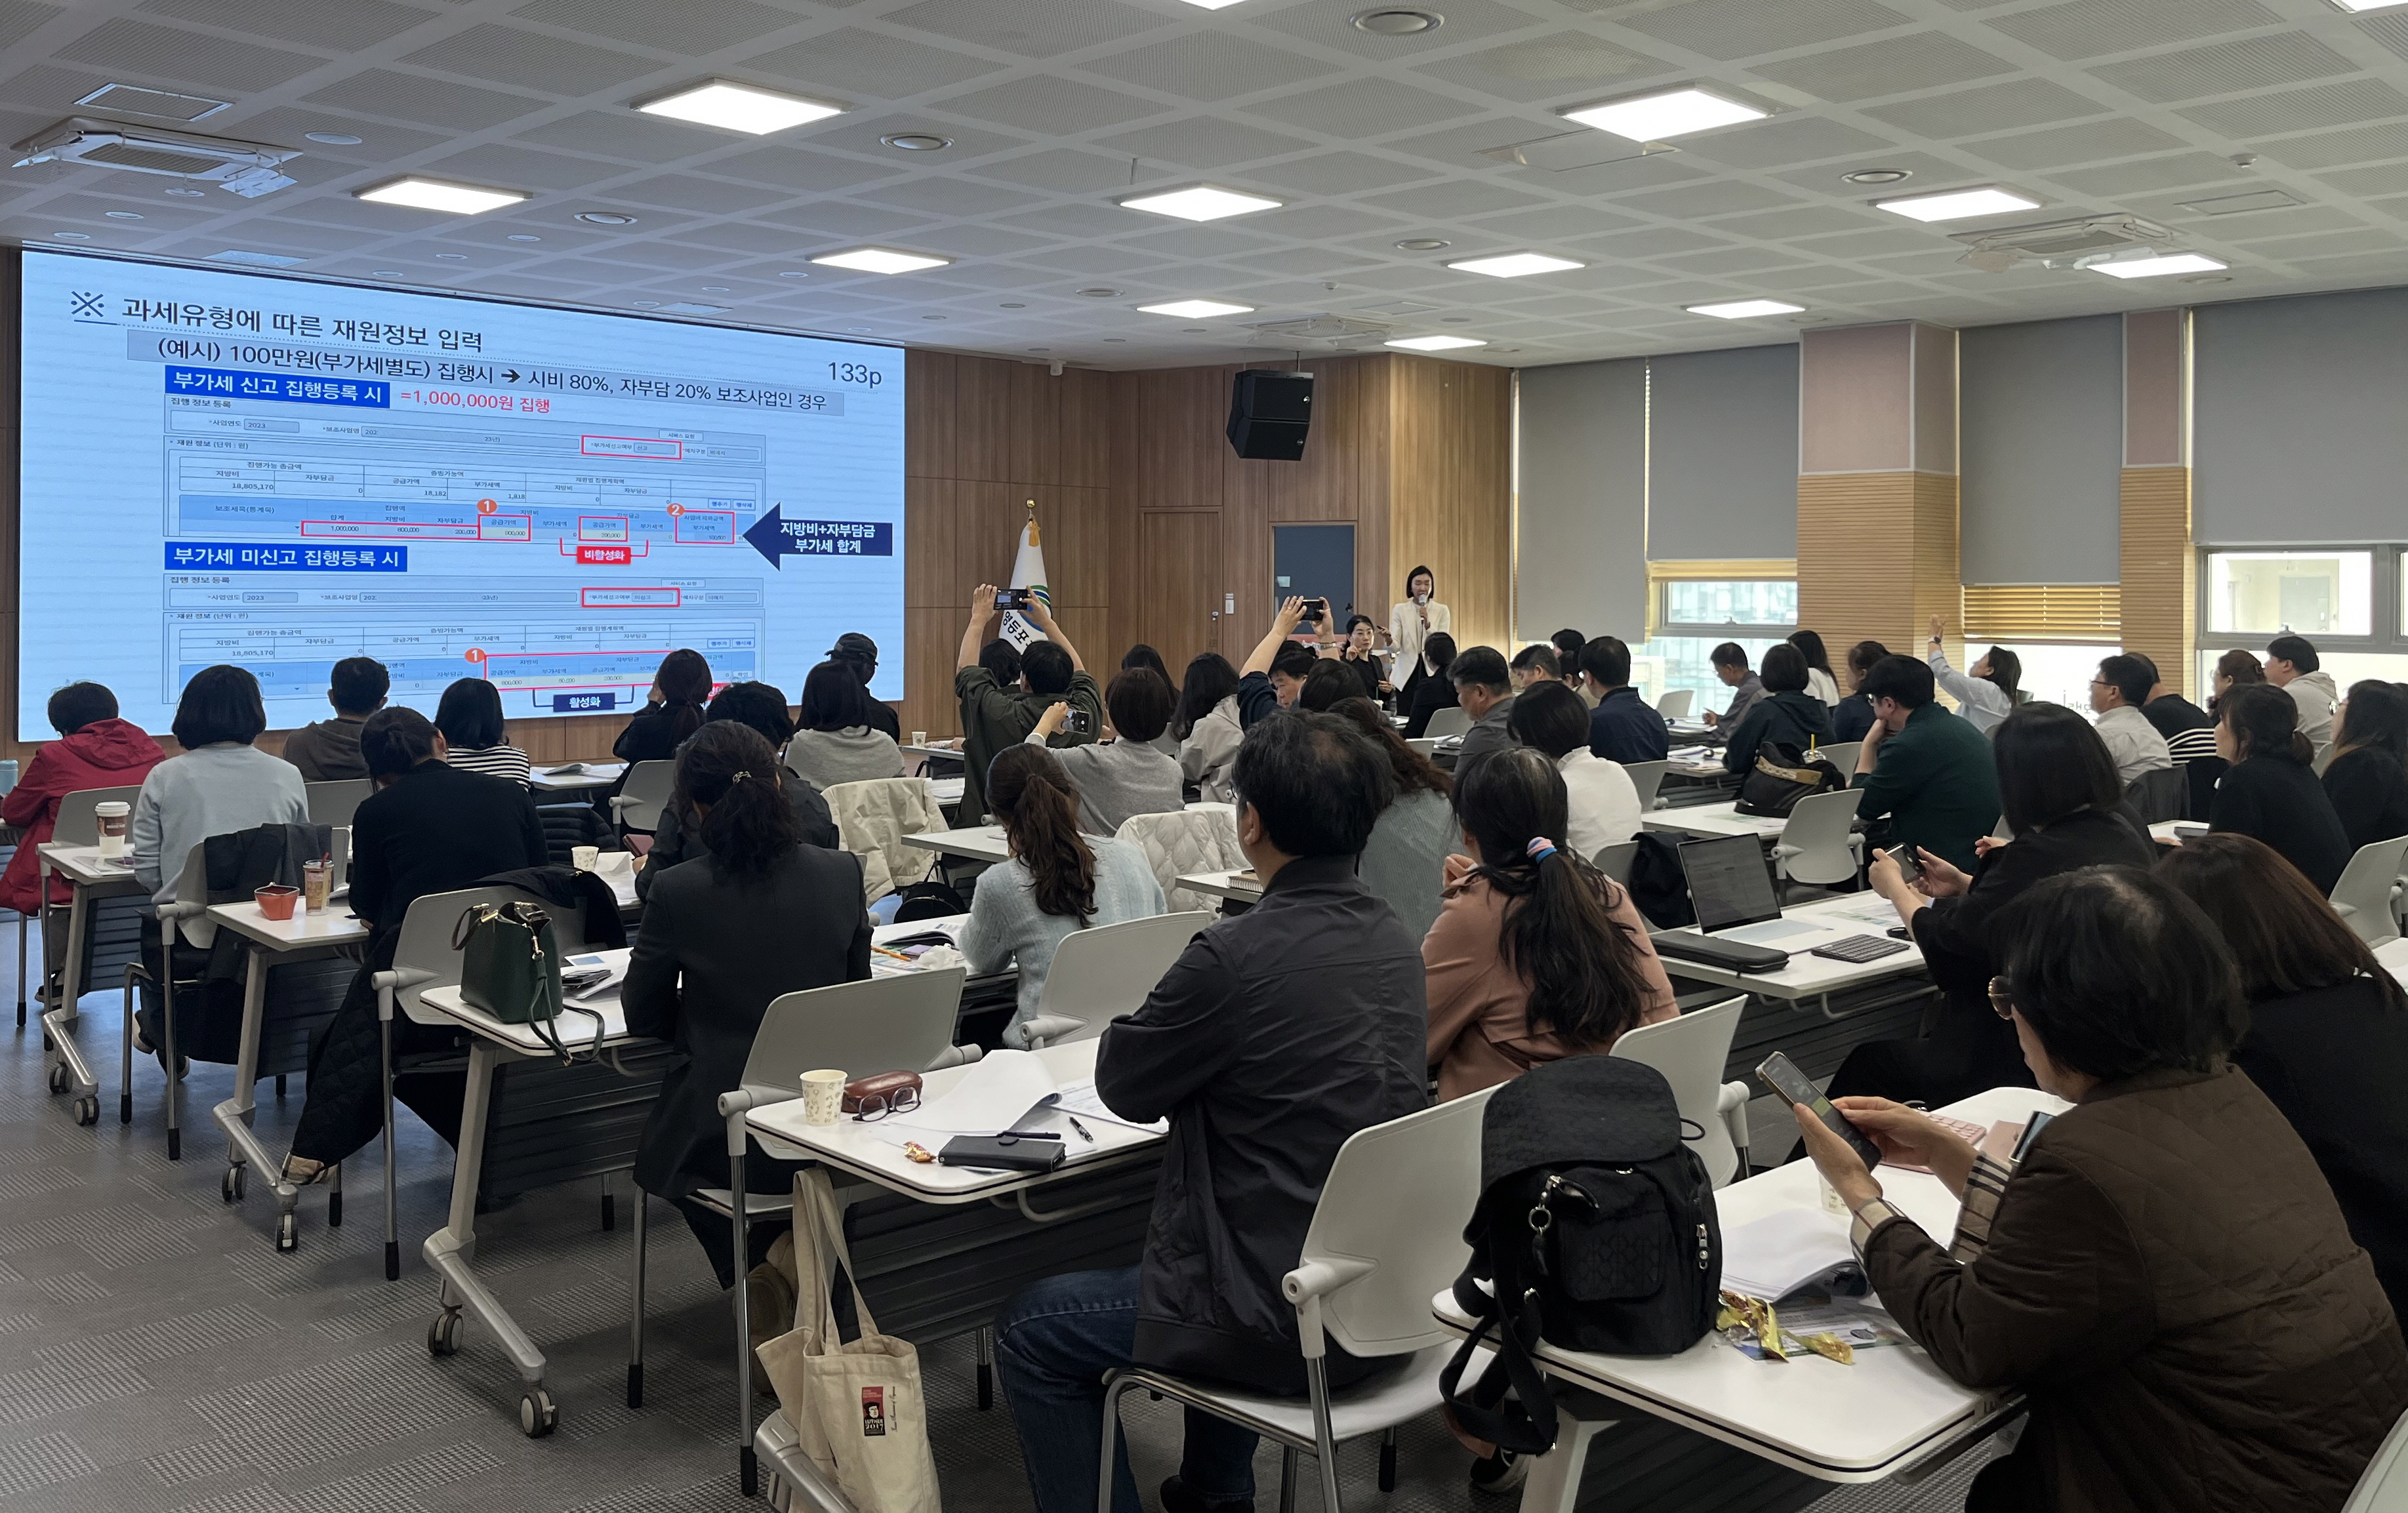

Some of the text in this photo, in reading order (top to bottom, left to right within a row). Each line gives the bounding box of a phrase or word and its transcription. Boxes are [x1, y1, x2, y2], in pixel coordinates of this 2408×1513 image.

[122, 298, 260, 333] 과세유형에
[273, 313, 323, 338] 따른
[332, 319, 428, 346] 재원정보
[438, 329, 481, 353] 입력
[158, 337, 826, 410] (예시) 100만원(부가세별도) 집행시 시비 80%, 자부담 20% 보조사업인 경우
[828, 362, 882, 388] 133p
[174, 372, 380, 403] 부가세 신고 집행등록 시
[171, 397, 190, 406] 집행
[401, 390, 550, 413] =1,000,000원 집행
[483, 500, 490, 512] 1
[671, 504, 680, 515] 2
[781, 522, 876, 538] 지방비+자부담금
[795, 539, 861, 554] 부가세 합계
[174, 548, 398, 567] 부가세 미신고 집행등록 시
[584, 550, 625, 561] 비활성화
[472, 650, 478, 660] 1
[569, 696, 600, 708] 활성화
